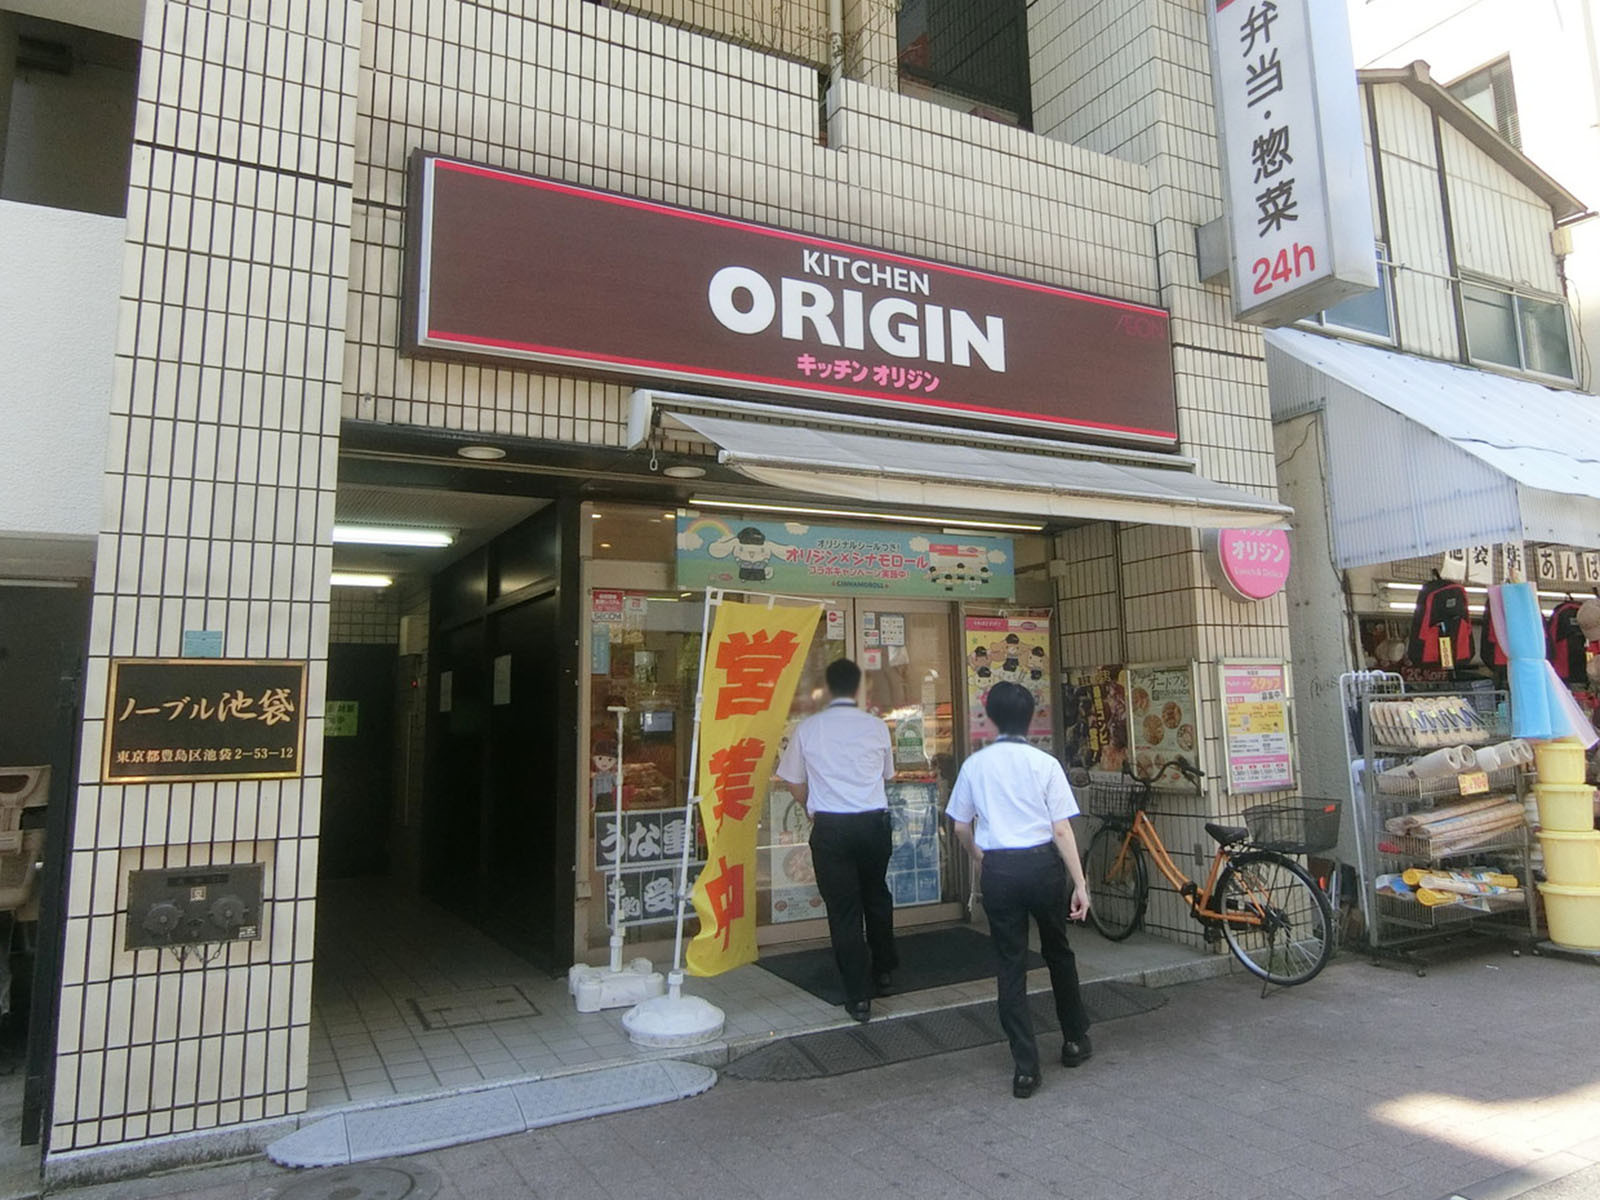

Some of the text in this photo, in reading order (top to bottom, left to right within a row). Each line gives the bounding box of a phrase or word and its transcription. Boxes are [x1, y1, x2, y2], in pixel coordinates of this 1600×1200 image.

[803, 249, 931, 296] KITCHEN
[1252, 242, 1316, 295] 24h
[708, 266, 1006, 373] ORIGIN
[797, 353, 940, 392] キッチン オリジン
[786, 548, 929, 569] オリジン×シナモロール
[1232, 540, 1285, 563] オリジン
[119, 687, 295, 726] ノーブル池袋
[705, 628, 800, 952] 営業中
[601, 819, 695, 861] うな重
